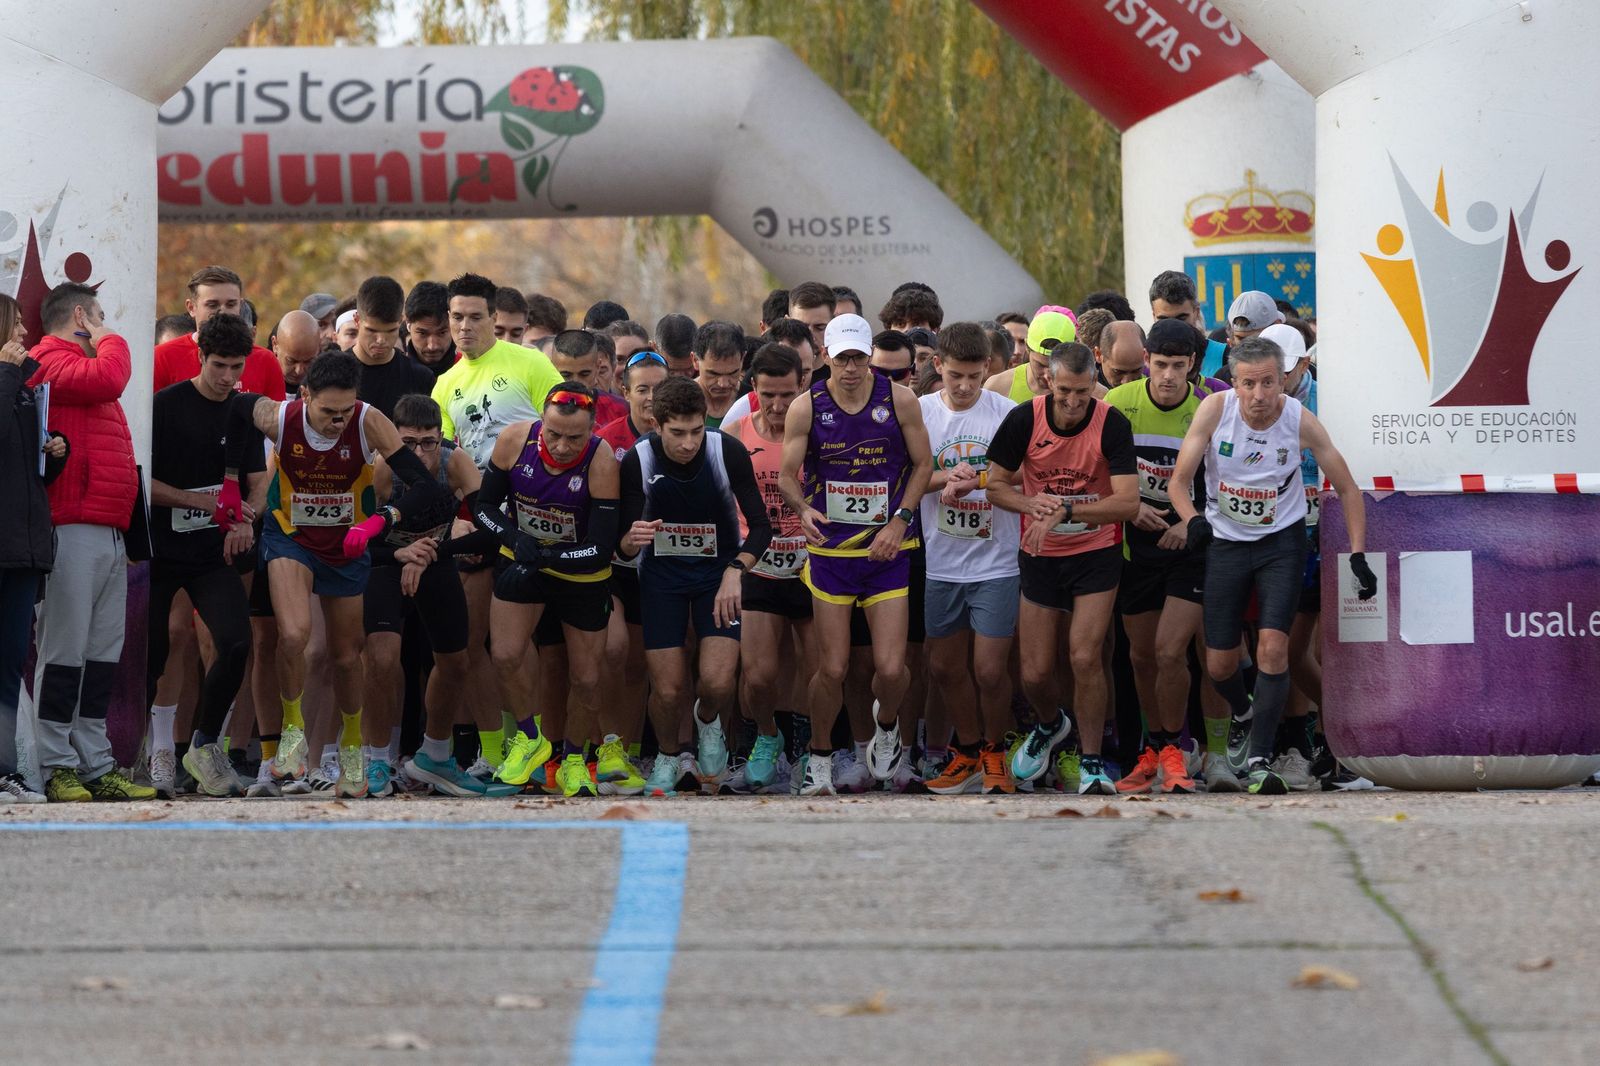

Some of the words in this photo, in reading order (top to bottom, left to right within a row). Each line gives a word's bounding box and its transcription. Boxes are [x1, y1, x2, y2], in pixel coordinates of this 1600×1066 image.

[787, 215, 892, 238] HOSPES
[1371, 413, 1446, 429] SERVICIO
[1451, 413, 1474, 427] DE
[1481, 409, 1577, 427] EDUCACIÓN
[1372, 428, 1431, 446] FÍSICA
[1446, 430, 1458, 443] Y
[1475, 428, 1577, 444] DEPORTES
[858, 446, 884, 455] PRIM
[827, 483, 887, 496] bedunia
[1219, 482, 1277, 499] bedunia
[292, 495, 353, 506] bedunia
[845, 497, 870, 514] 23
[1229, 497, 1265, 516] 333
[304, 505, 342, 518] 943
[517, 502, 575, 525] bedunia
[946, 509, 981, 529] 318
[528, 517, 563, 534] 480
[655, 525, 715, 535] bedunia
[668, 534, 704, 548] 153
[569, 545, 599, 559] TERREX
[761, 552, 797, 568] 459
